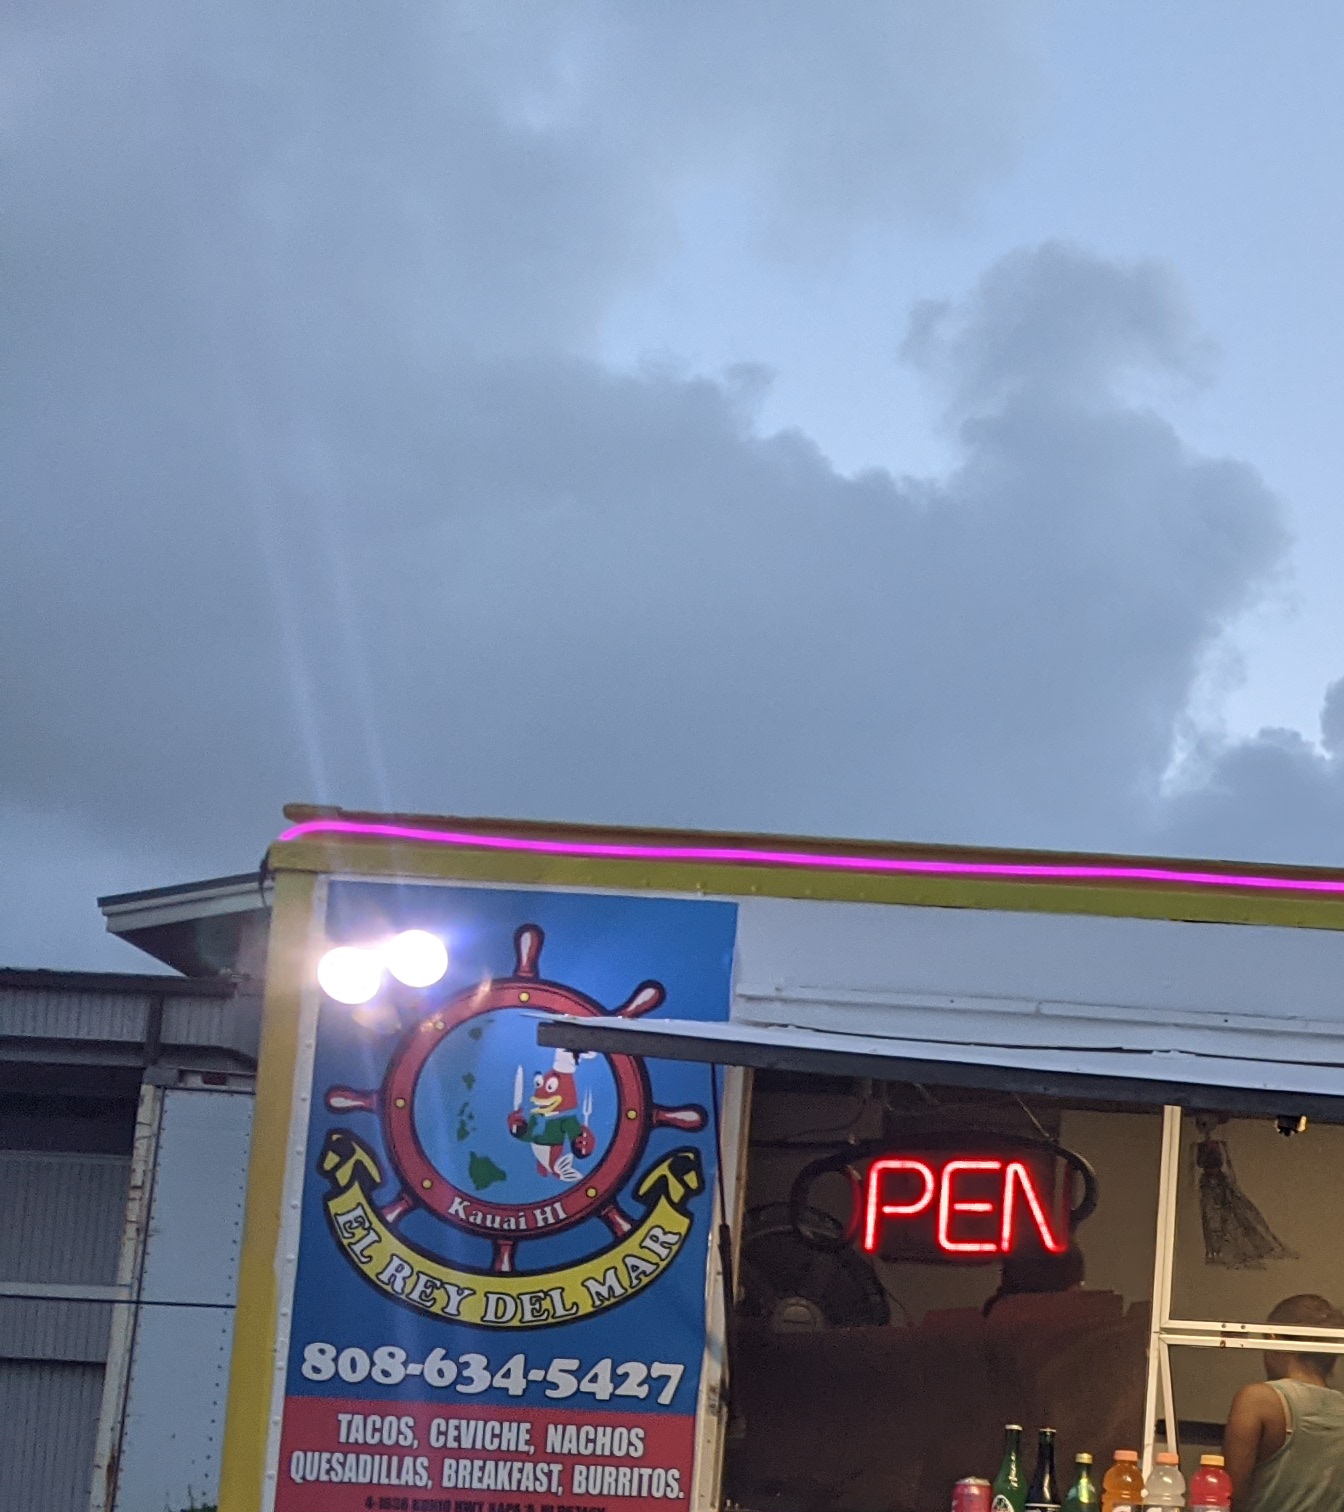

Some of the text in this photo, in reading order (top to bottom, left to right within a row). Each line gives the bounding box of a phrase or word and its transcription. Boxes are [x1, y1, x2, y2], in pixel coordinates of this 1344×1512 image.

[448, 1196, 567, 1230] Kauai HI
[335, 1204, 682, 1325] EL REY DEL MAR
[301, 1342, 684, 1405] 808-634-5427
[337, 1413, 645, 1458] TACOS, CEVICHE, NACHOS
[290, 1450, 684, 1499] QUESADILLAS, BREAKFAST, BURRITOS.
